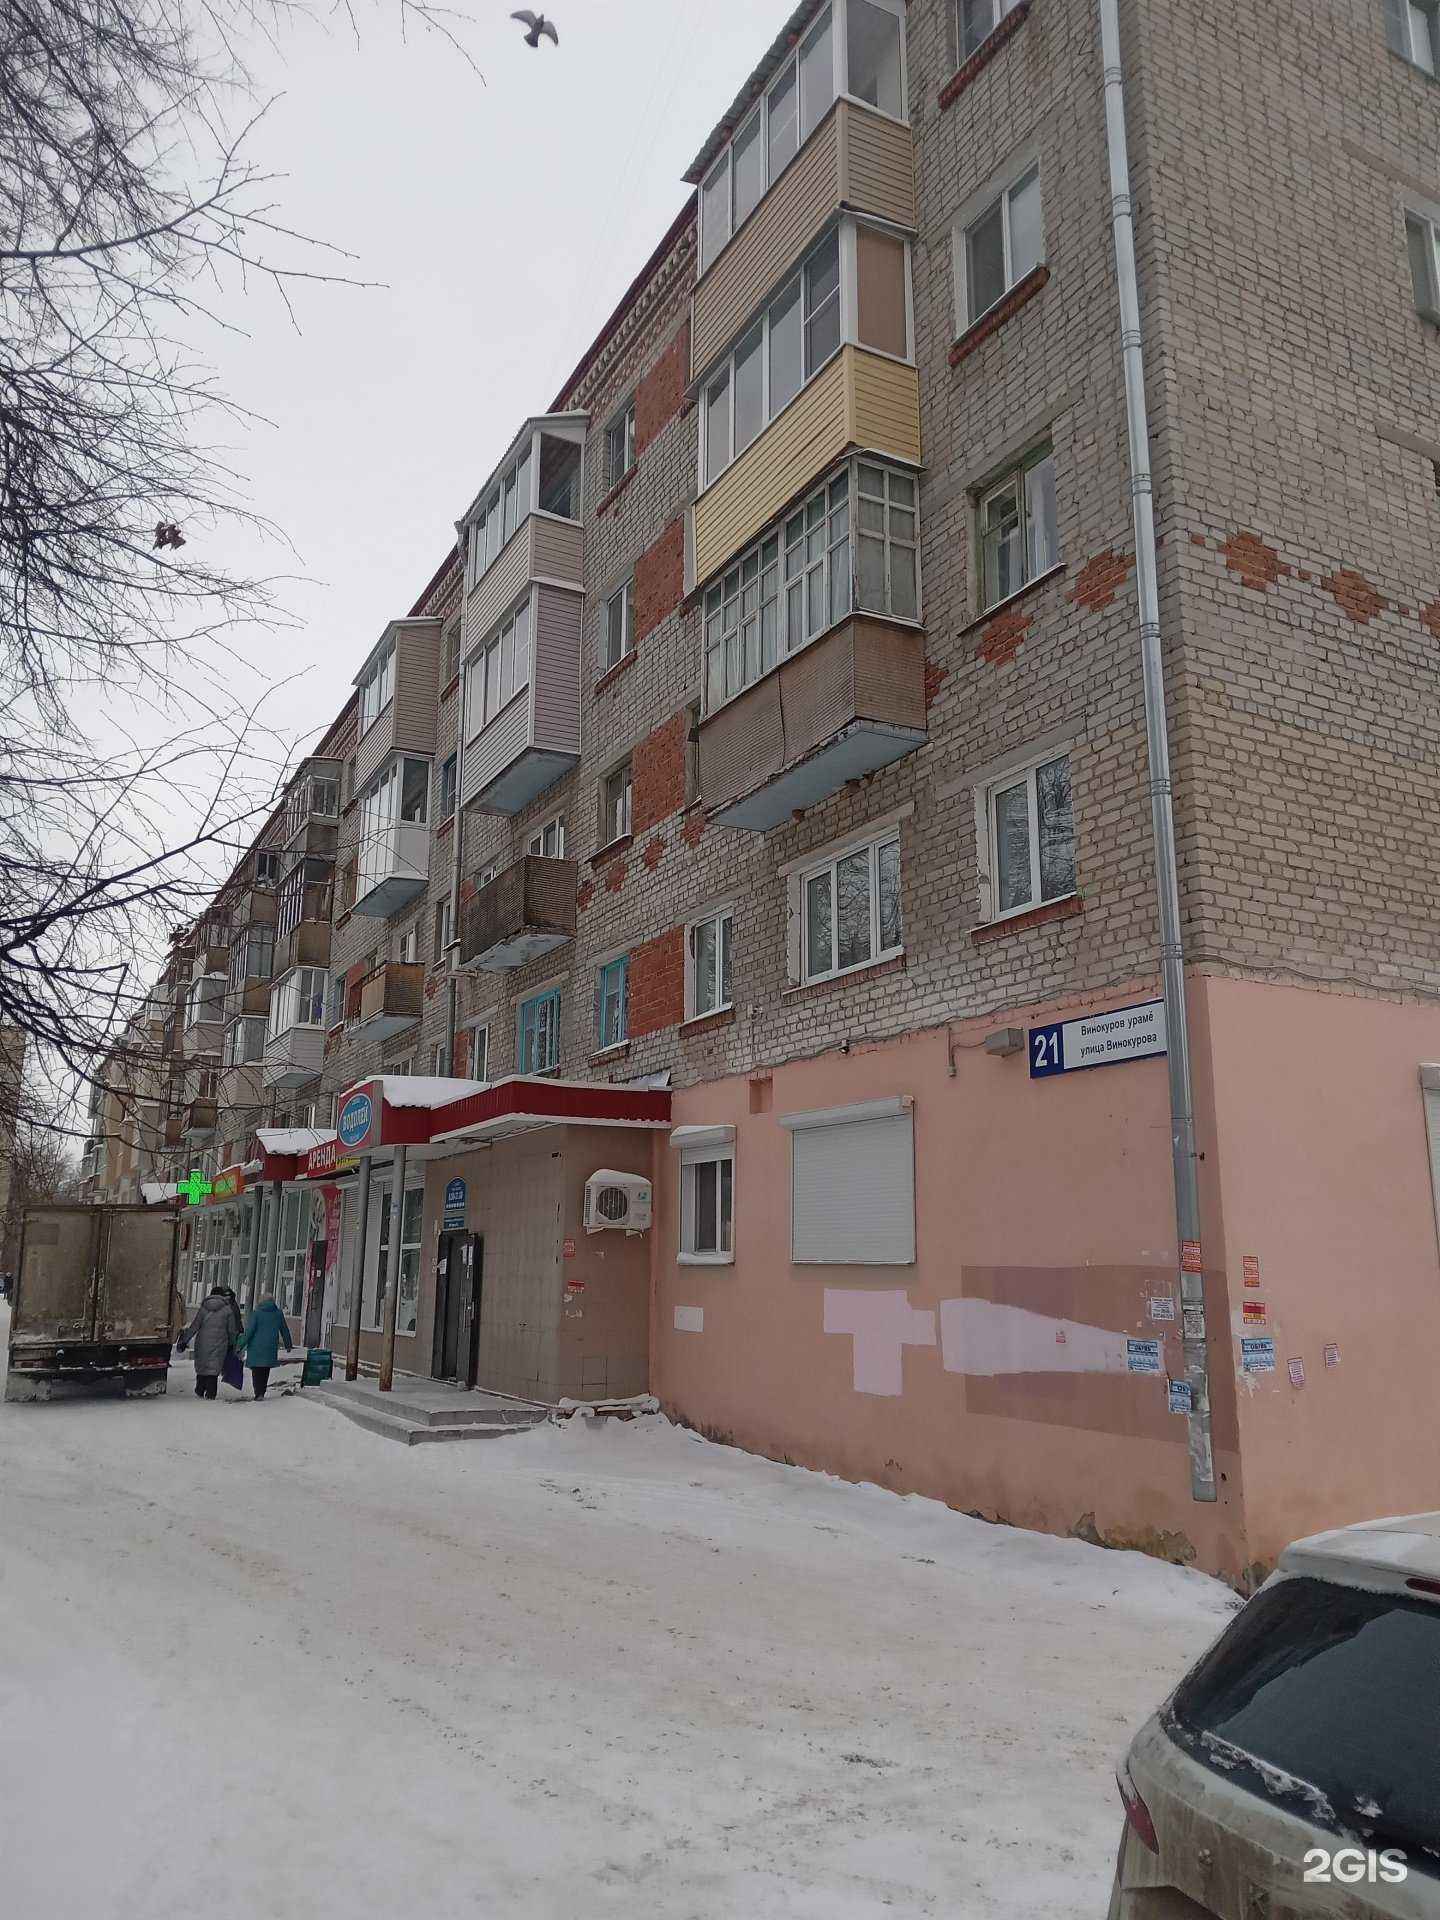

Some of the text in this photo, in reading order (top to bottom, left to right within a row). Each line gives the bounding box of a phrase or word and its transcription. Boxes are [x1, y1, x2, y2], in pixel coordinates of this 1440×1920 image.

[1081, 1020, 1125, 1036] Винокуров
[1034, 1031, 1059, 1068] 21
[1080, 1033, 1157, 1058] улица Винокурова
[308, 1143, 336, 1170] АРЕНДА
